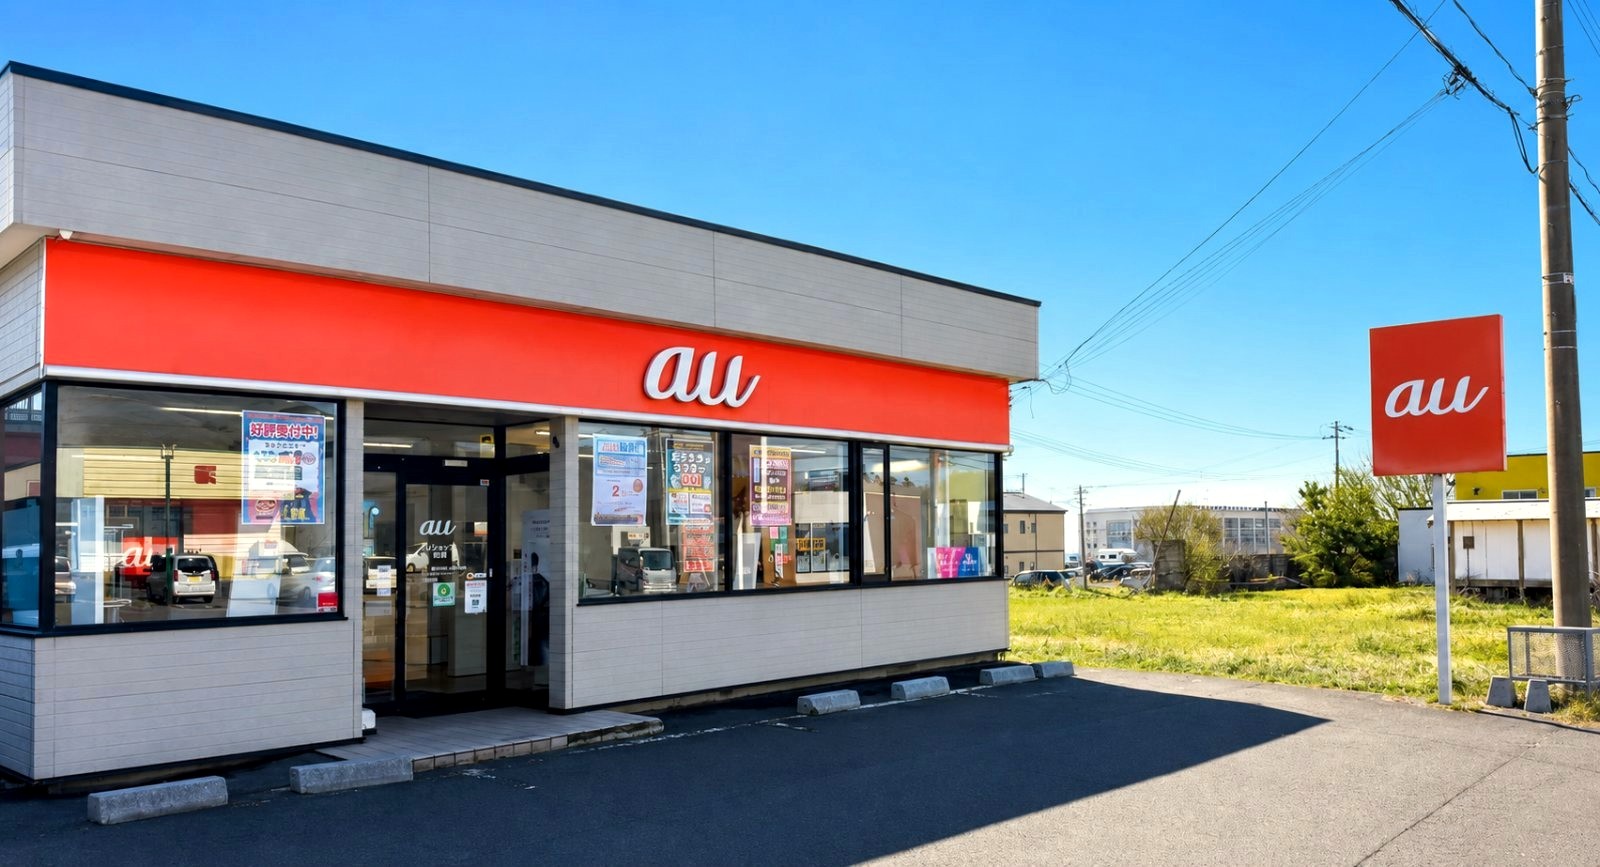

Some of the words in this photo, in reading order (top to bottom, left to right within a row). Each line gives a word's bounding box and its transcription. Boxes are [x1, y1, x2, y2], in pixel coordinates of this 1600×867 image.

[643, 346, 761, 408] au
[1385, 376, 1489, 418] au
[419, 519, 457, 536] au
